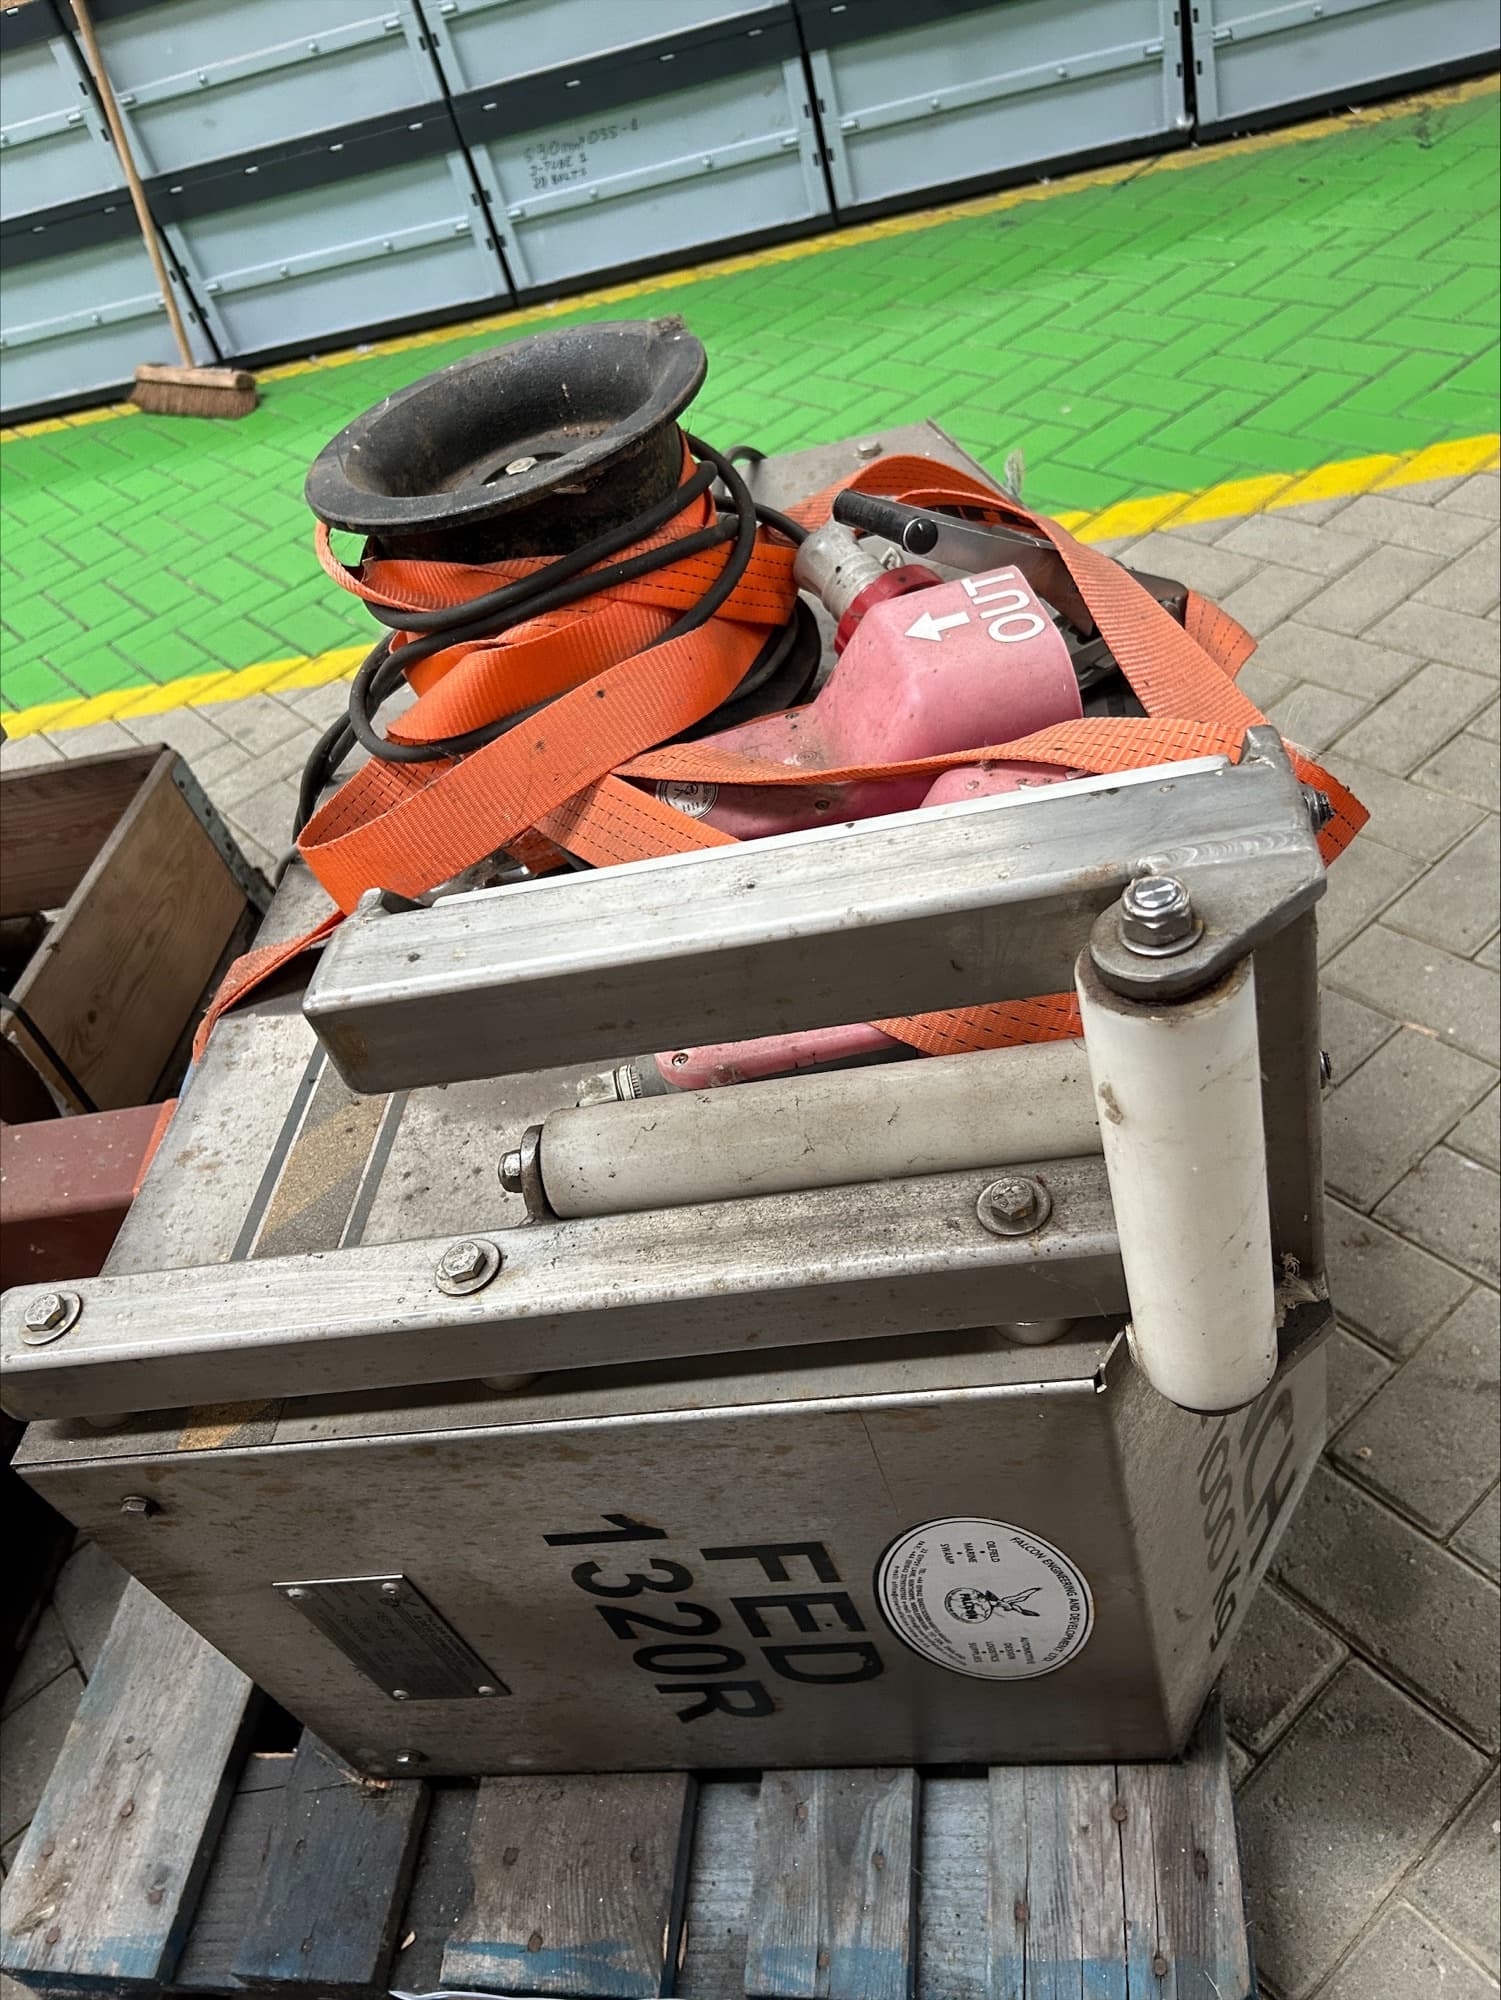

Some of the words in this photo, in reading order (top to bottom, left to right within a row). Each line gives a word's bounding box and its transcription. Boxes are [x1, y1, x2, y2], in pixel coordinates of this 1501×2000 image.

[961, 572, 1045, 643] OUT
[940, 1543, 955, 1565] SWAMP
[964, 1542, 978, 1563] MARINE
[986, 1540, 1000, 1563] OILFIELD
[1010, 1536, 1046, 1559] FALCON
[1042, 1558, 1077, 1597] ENGINEERING
[541, 1513, 778, 1725] 1320R
[699, 1541, 884, 1688] FED
[1068, 1597, 1080, 1613] AND
[1056, 1613, 1080, 1653] DEVELOPMENT
